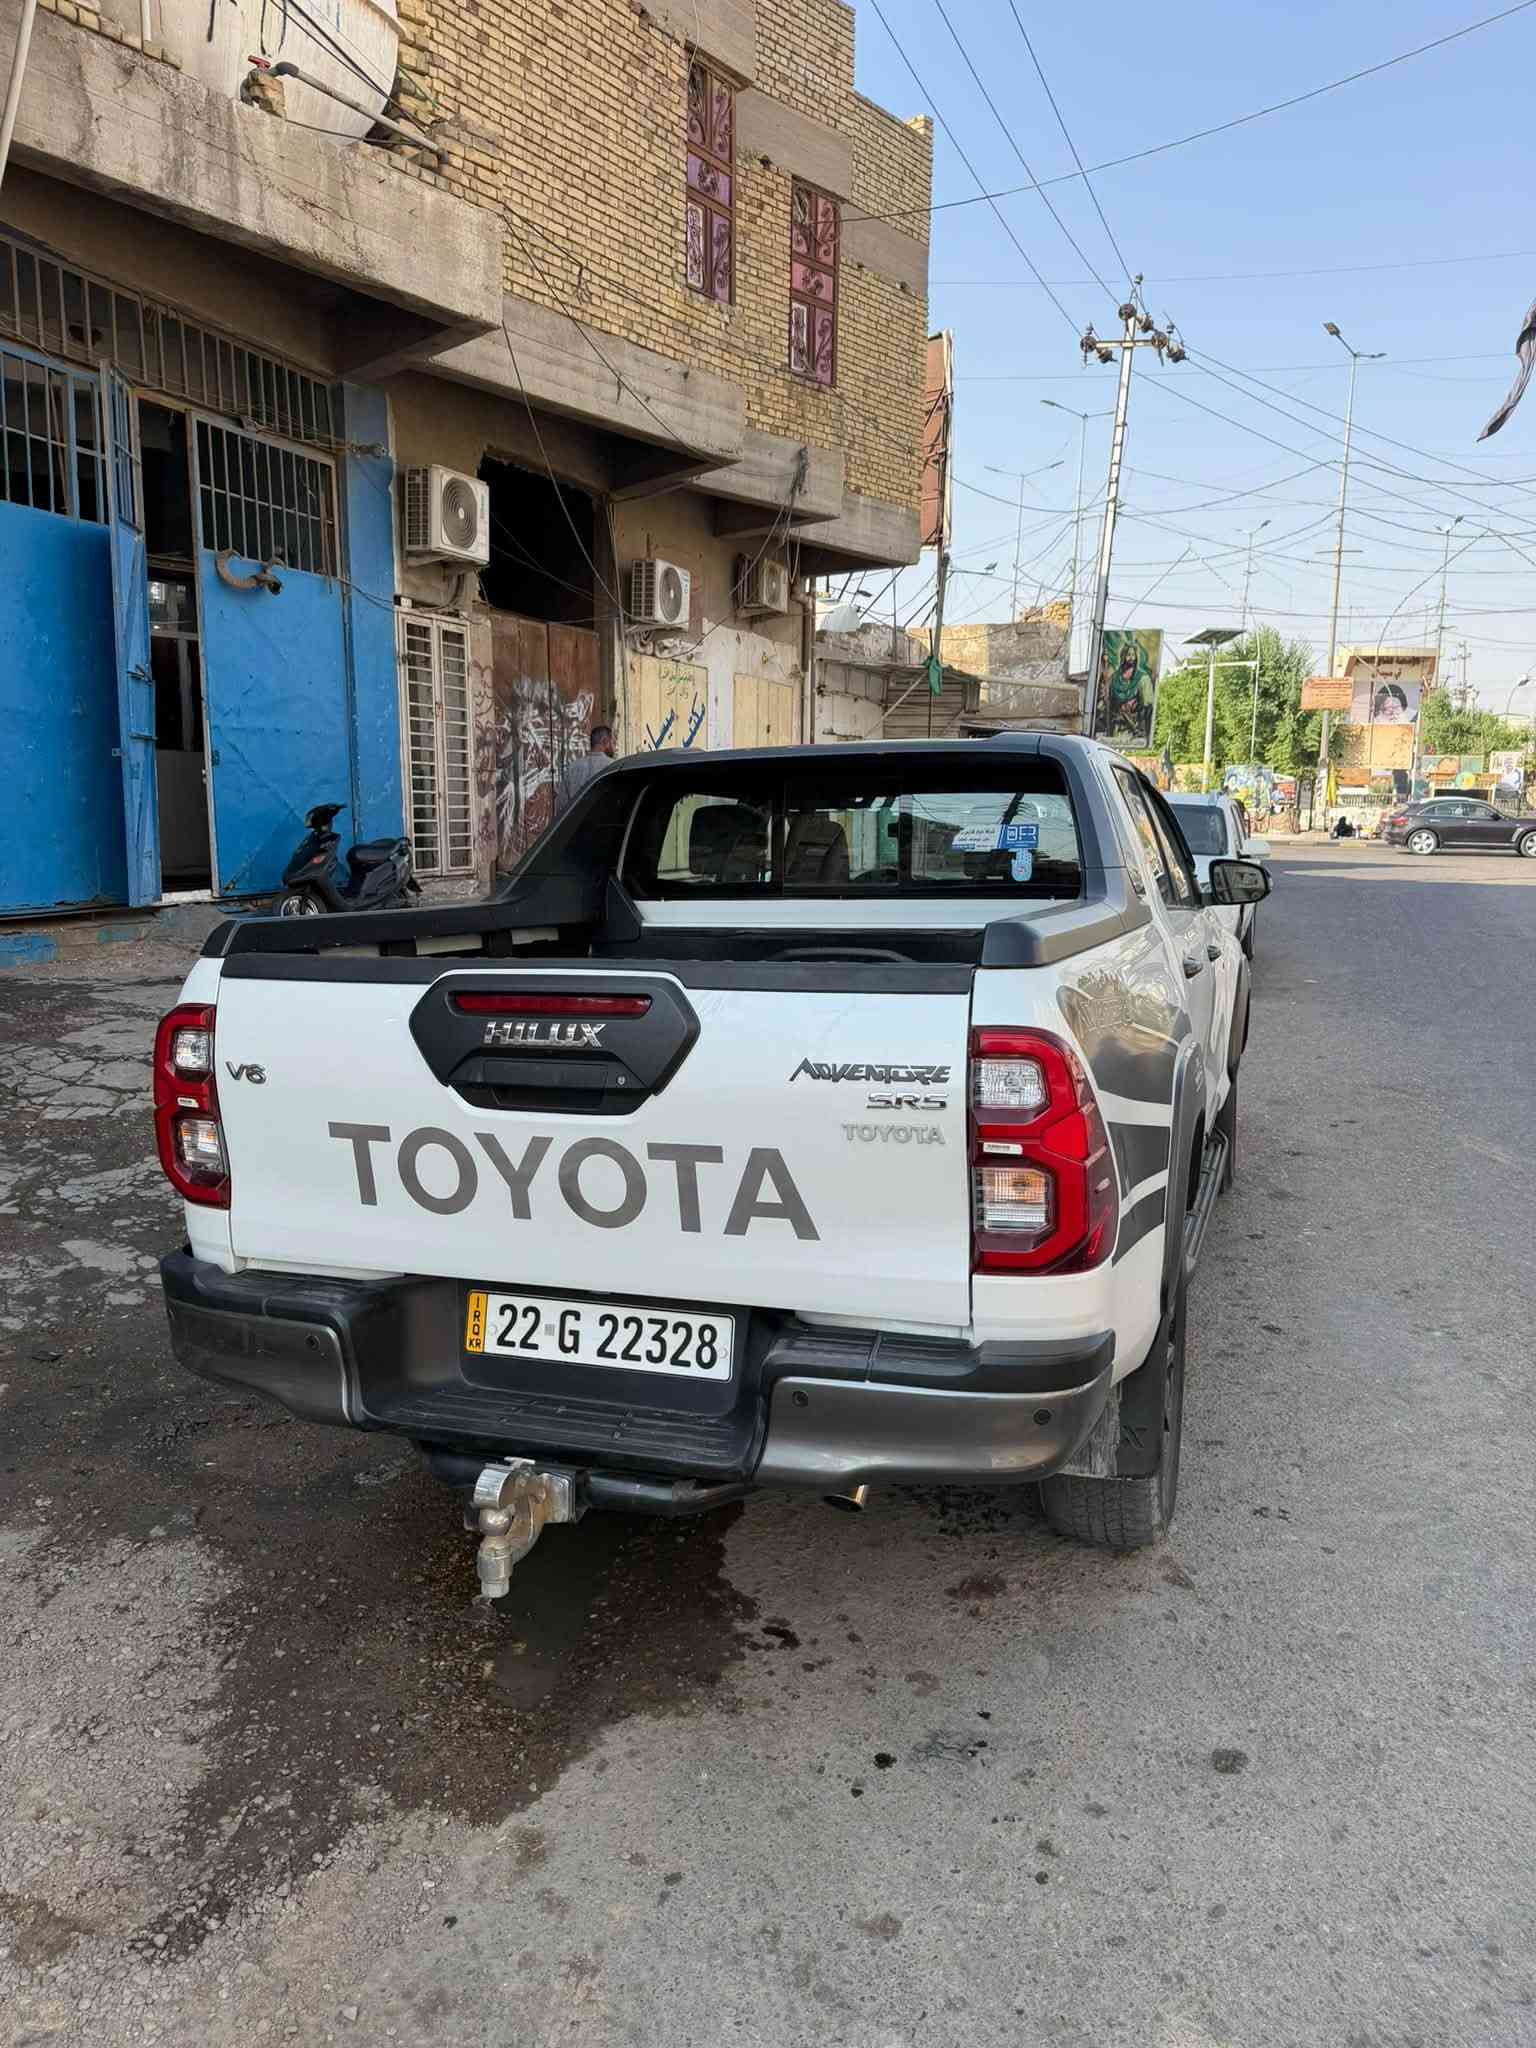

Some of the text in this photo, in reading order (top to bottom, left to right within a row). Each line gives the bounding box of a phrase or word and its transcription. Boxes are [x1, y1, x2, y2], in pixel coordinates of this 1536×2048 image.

[483, 1021, 606, 1047] HILUX
[225, 1061, 267, 1085] V6
[789, 1057, 952, 1085] ADVENTURE
[866, 1092, 949, 1110] SRS
[841, 1122, 946, 1145] TOYOTA
[328, 1121, 821, 1241] TOYOTA
[497, 1303, 718, 1370] 22 G 22328
